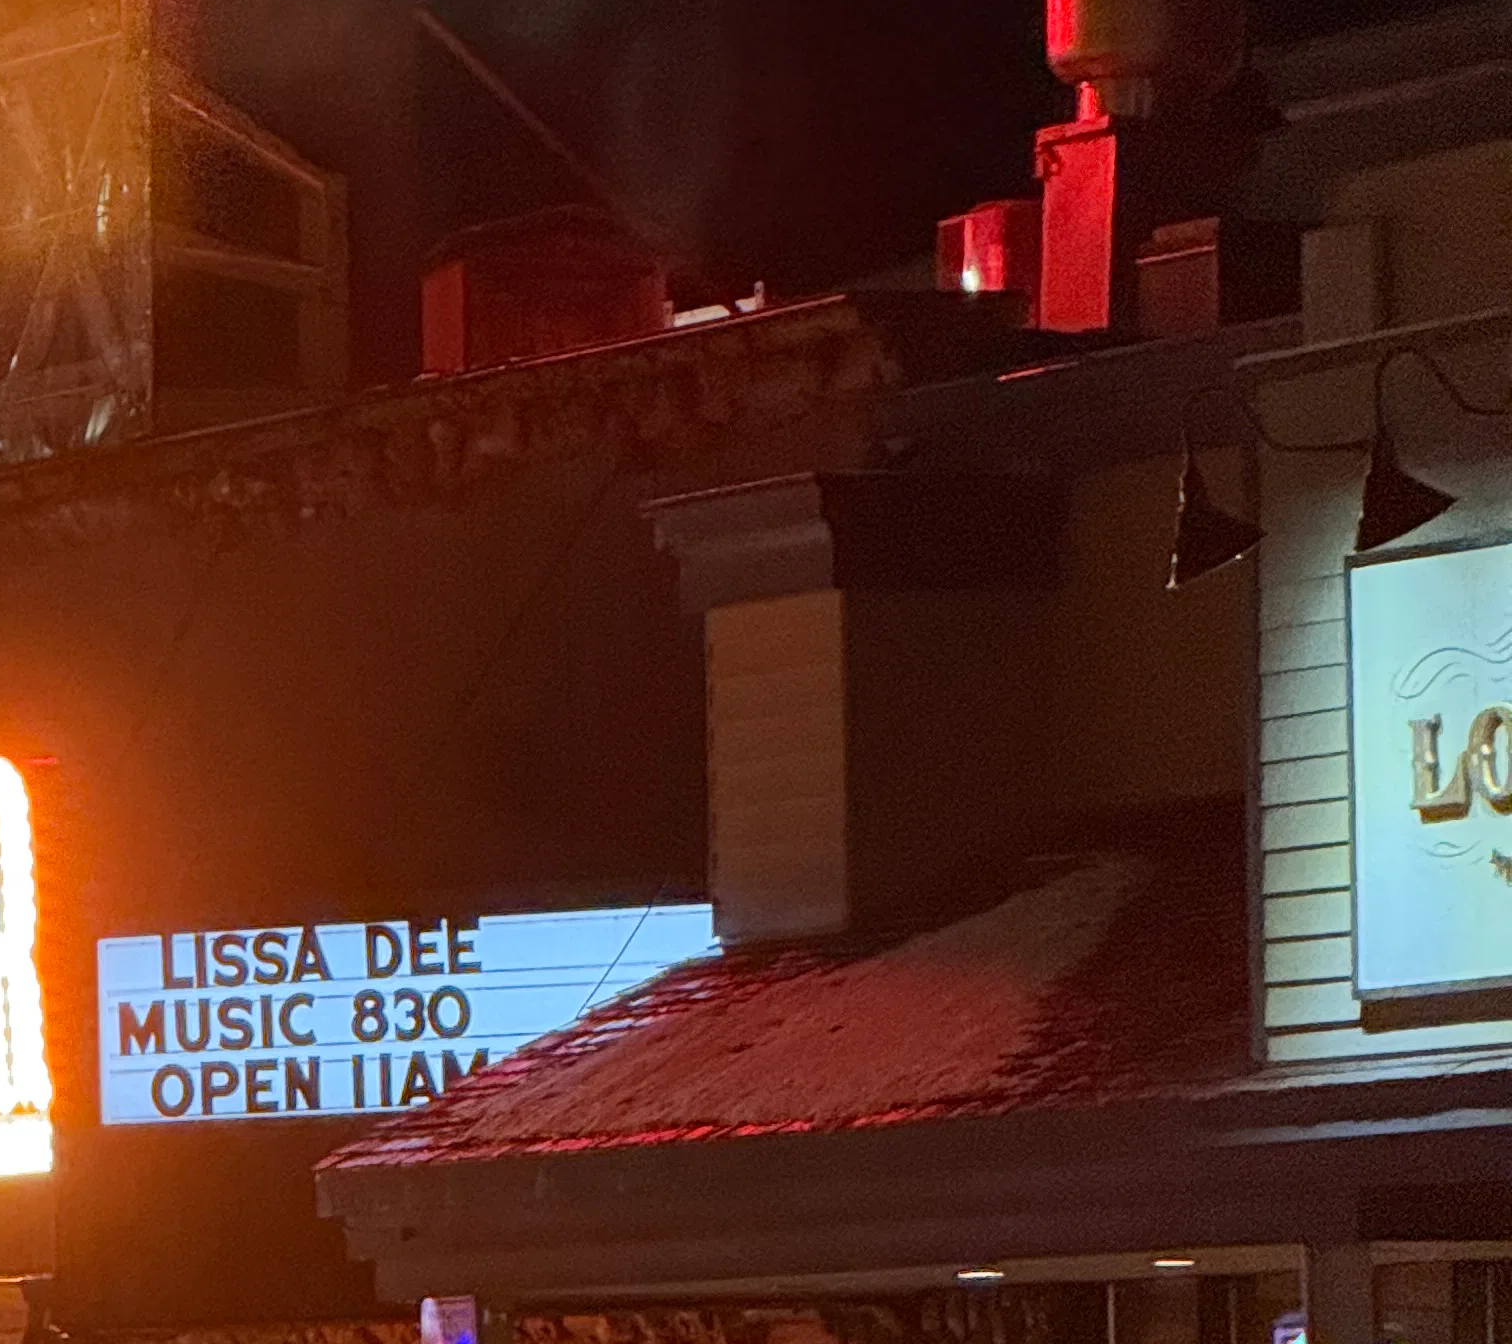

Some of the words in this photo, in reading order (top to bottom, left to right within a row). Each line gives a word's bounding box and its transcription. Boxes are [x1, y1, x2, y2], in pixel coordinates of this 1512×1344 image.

[161, 926, 333, 990] LISSA
[365, 917, 482, 977] DEE
[118, 992, 317, 1056] MUSIC
[352, 984, 472, 1043] 830
[151, 1056, 321, 1119] OPEN
